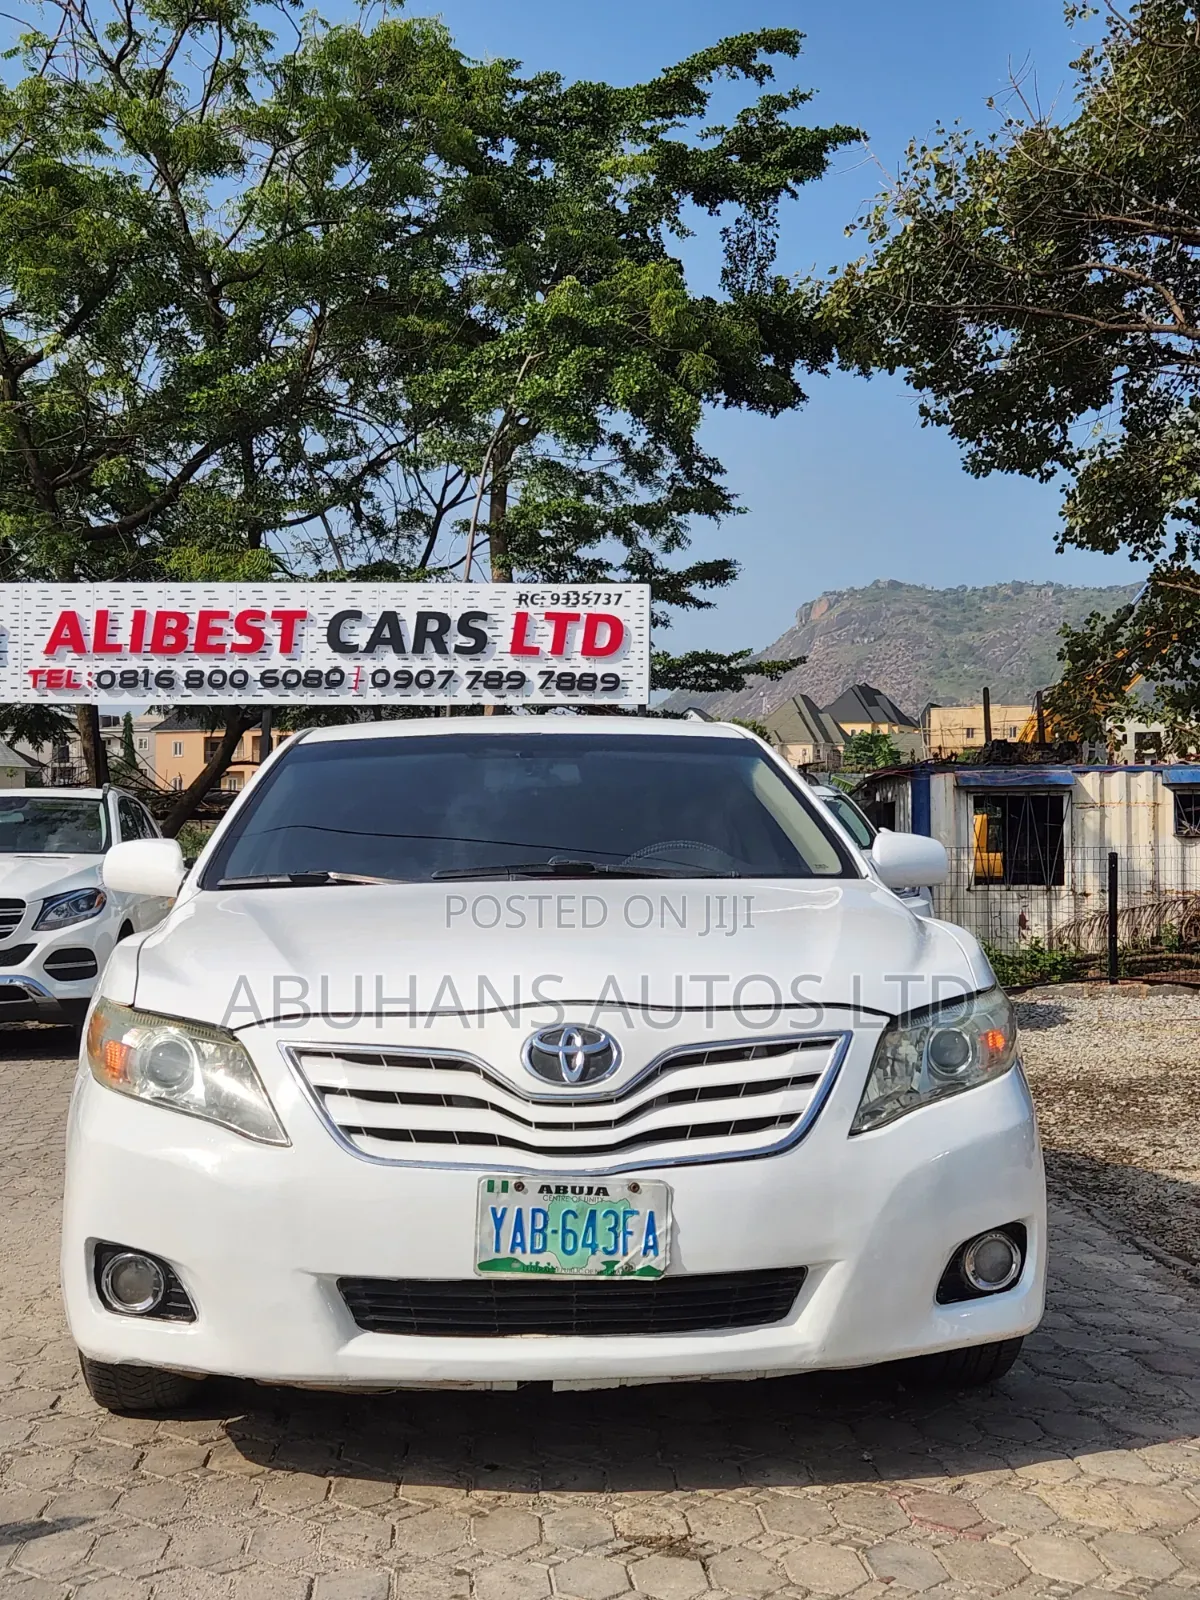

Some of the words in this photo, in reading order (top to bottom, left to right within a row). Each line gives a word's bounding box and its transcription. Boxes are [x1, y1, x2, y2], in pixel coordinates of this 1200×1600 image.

[518, 593, 544, 606] RC:
[550, 593, 623, 606] 9335737
[43, 609, 308, 655] ALIBEST
[326, 609, 488, 655] CARS
[509, 611, 625, 657] LTD
[96, 669, 175, 690] 0816
[184, 669, 250, 690] 800
[259, 668, 346, 690] 6080
[370, 668, 455, 690] 0907
[465, 670, 527, 691] 789
[537, 670, 622, 693] 7889
[537, 1184, 610, 1197] ABUJA
[542, 1194, 570, 1203] CENTRE
[490, 1206, 660, 1257] YAB-643FA
